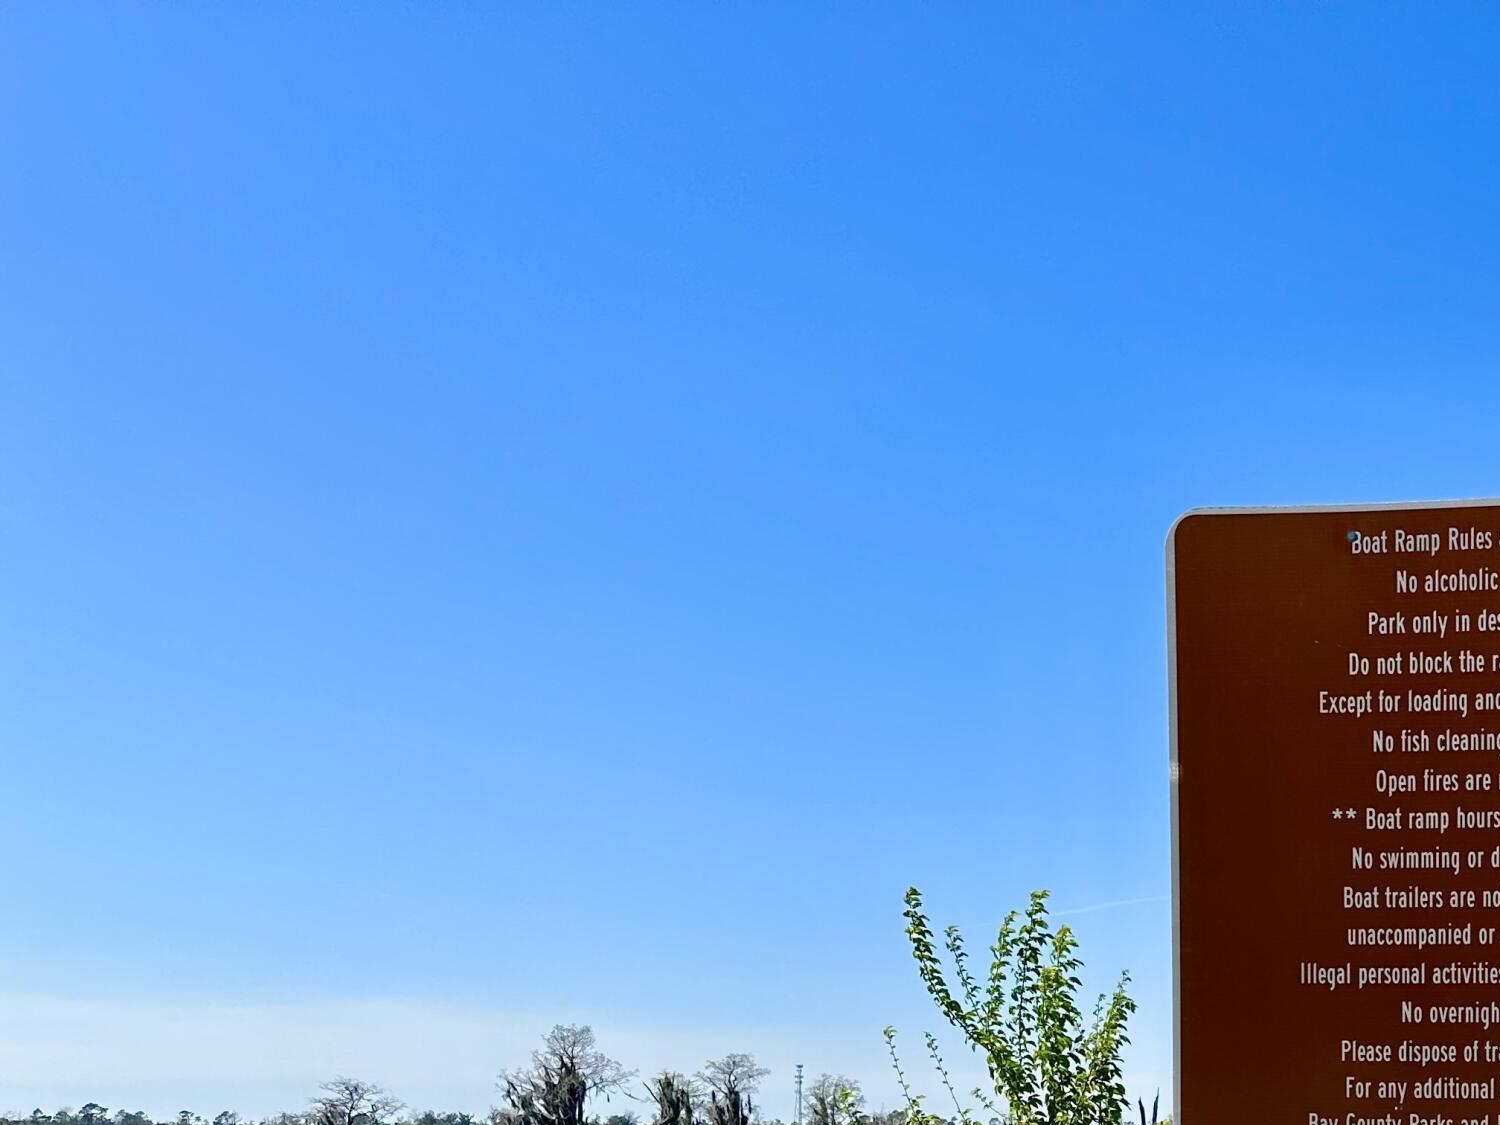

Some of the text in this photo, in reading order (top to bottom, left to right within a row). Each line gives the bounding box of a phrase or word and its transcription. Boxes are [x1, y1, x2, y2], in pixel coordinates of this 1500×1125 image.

[1351, 531, 1387, 553] Boat
[1396, 530, 1440, 556] Ramp
[1449, 527, 1492, 550] Rules
[1397, 571, 1417, 592] No
[1425, 568, 1498, 592] alcoholic
[1369, 612, 1405, 634] Park
[1413, 611, 1447, 638] only
[1456, 609, 1469, 632] in
[1350, 653, 1369, 675] Do
[1378, 652, 1402, 674] not
[1410, 651, 1452, 673] block
[1459, 650, 1484, 672] the
[1320, 691, 1372, 717] Except
[1379, 690, 1400, 712] for
[1409, 689, 1467, 717] loading
[1374, 731, 1393, 752] No
[1401, 730, 1429, 751] fish
[1377, 770, 1416, 797] Open
[1424, 769, 1458, 791] fires
[1466, 774, 1491, 790] are
[1367, 808, 1401, 829] Boat
[1409, 812, 1448, 833] ramp
[1353, 848, 1372, 869] No
[1380, 846, 1459, 875] swimming
[1468, 852, 1484, 868] or
[1344, 887, 1379, 908] Boat
[1385, 886, 1443, 908] trailers
[1450, 891, 1475, 907] are
[1348, 923, 1470, 949] unaccompanied
[1479, 928, 1495, 944] or
[1301, 963, 1350, 990] Illegal
[1359, 963, 1424, 988] personal
[1402, 1001, 1422, 1023] No
[1342, 1040, 1391, 1061] Please
[1399, 1040, 1456, 1066] dispose
[1464, 1040, 1478, 1062] of
[1347, 1077, 1371, 1098] For
[1378, 1082, 1407, 1103] any
[1414, 1077, 1494, 1099] additional
